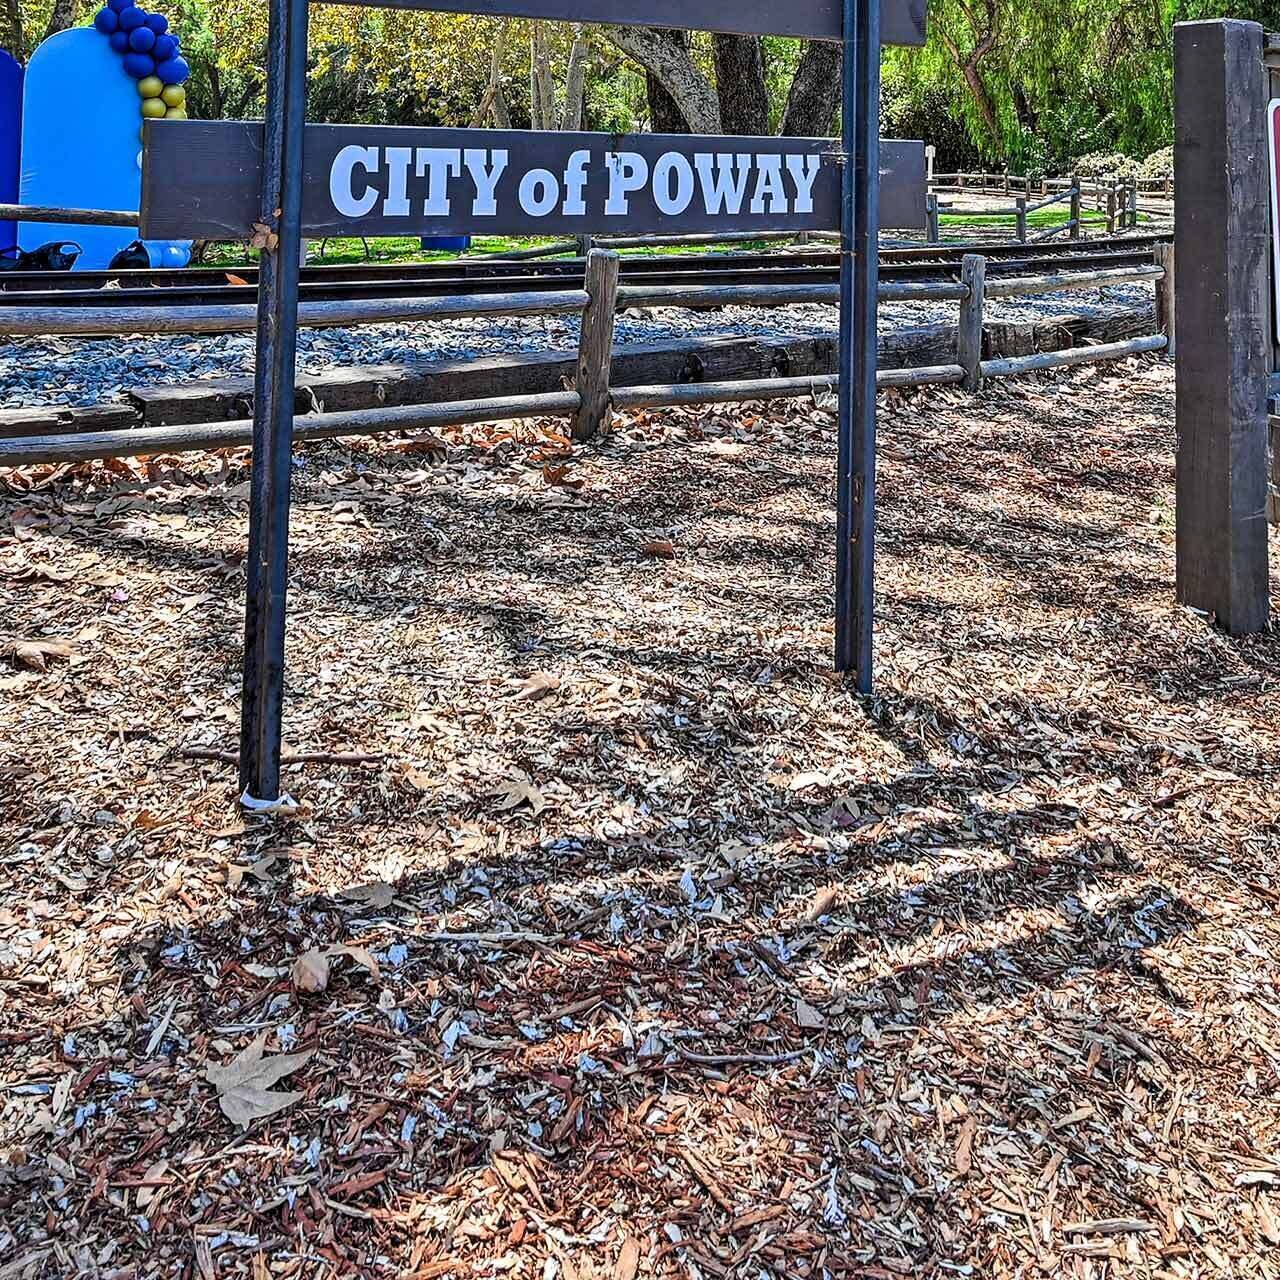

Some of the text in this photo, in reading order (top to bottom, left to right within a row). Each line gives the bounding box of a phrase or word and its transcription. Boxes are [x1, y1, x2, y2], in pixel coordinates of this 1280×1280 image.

[329, 144, 821, 218] CITY of POWAY
